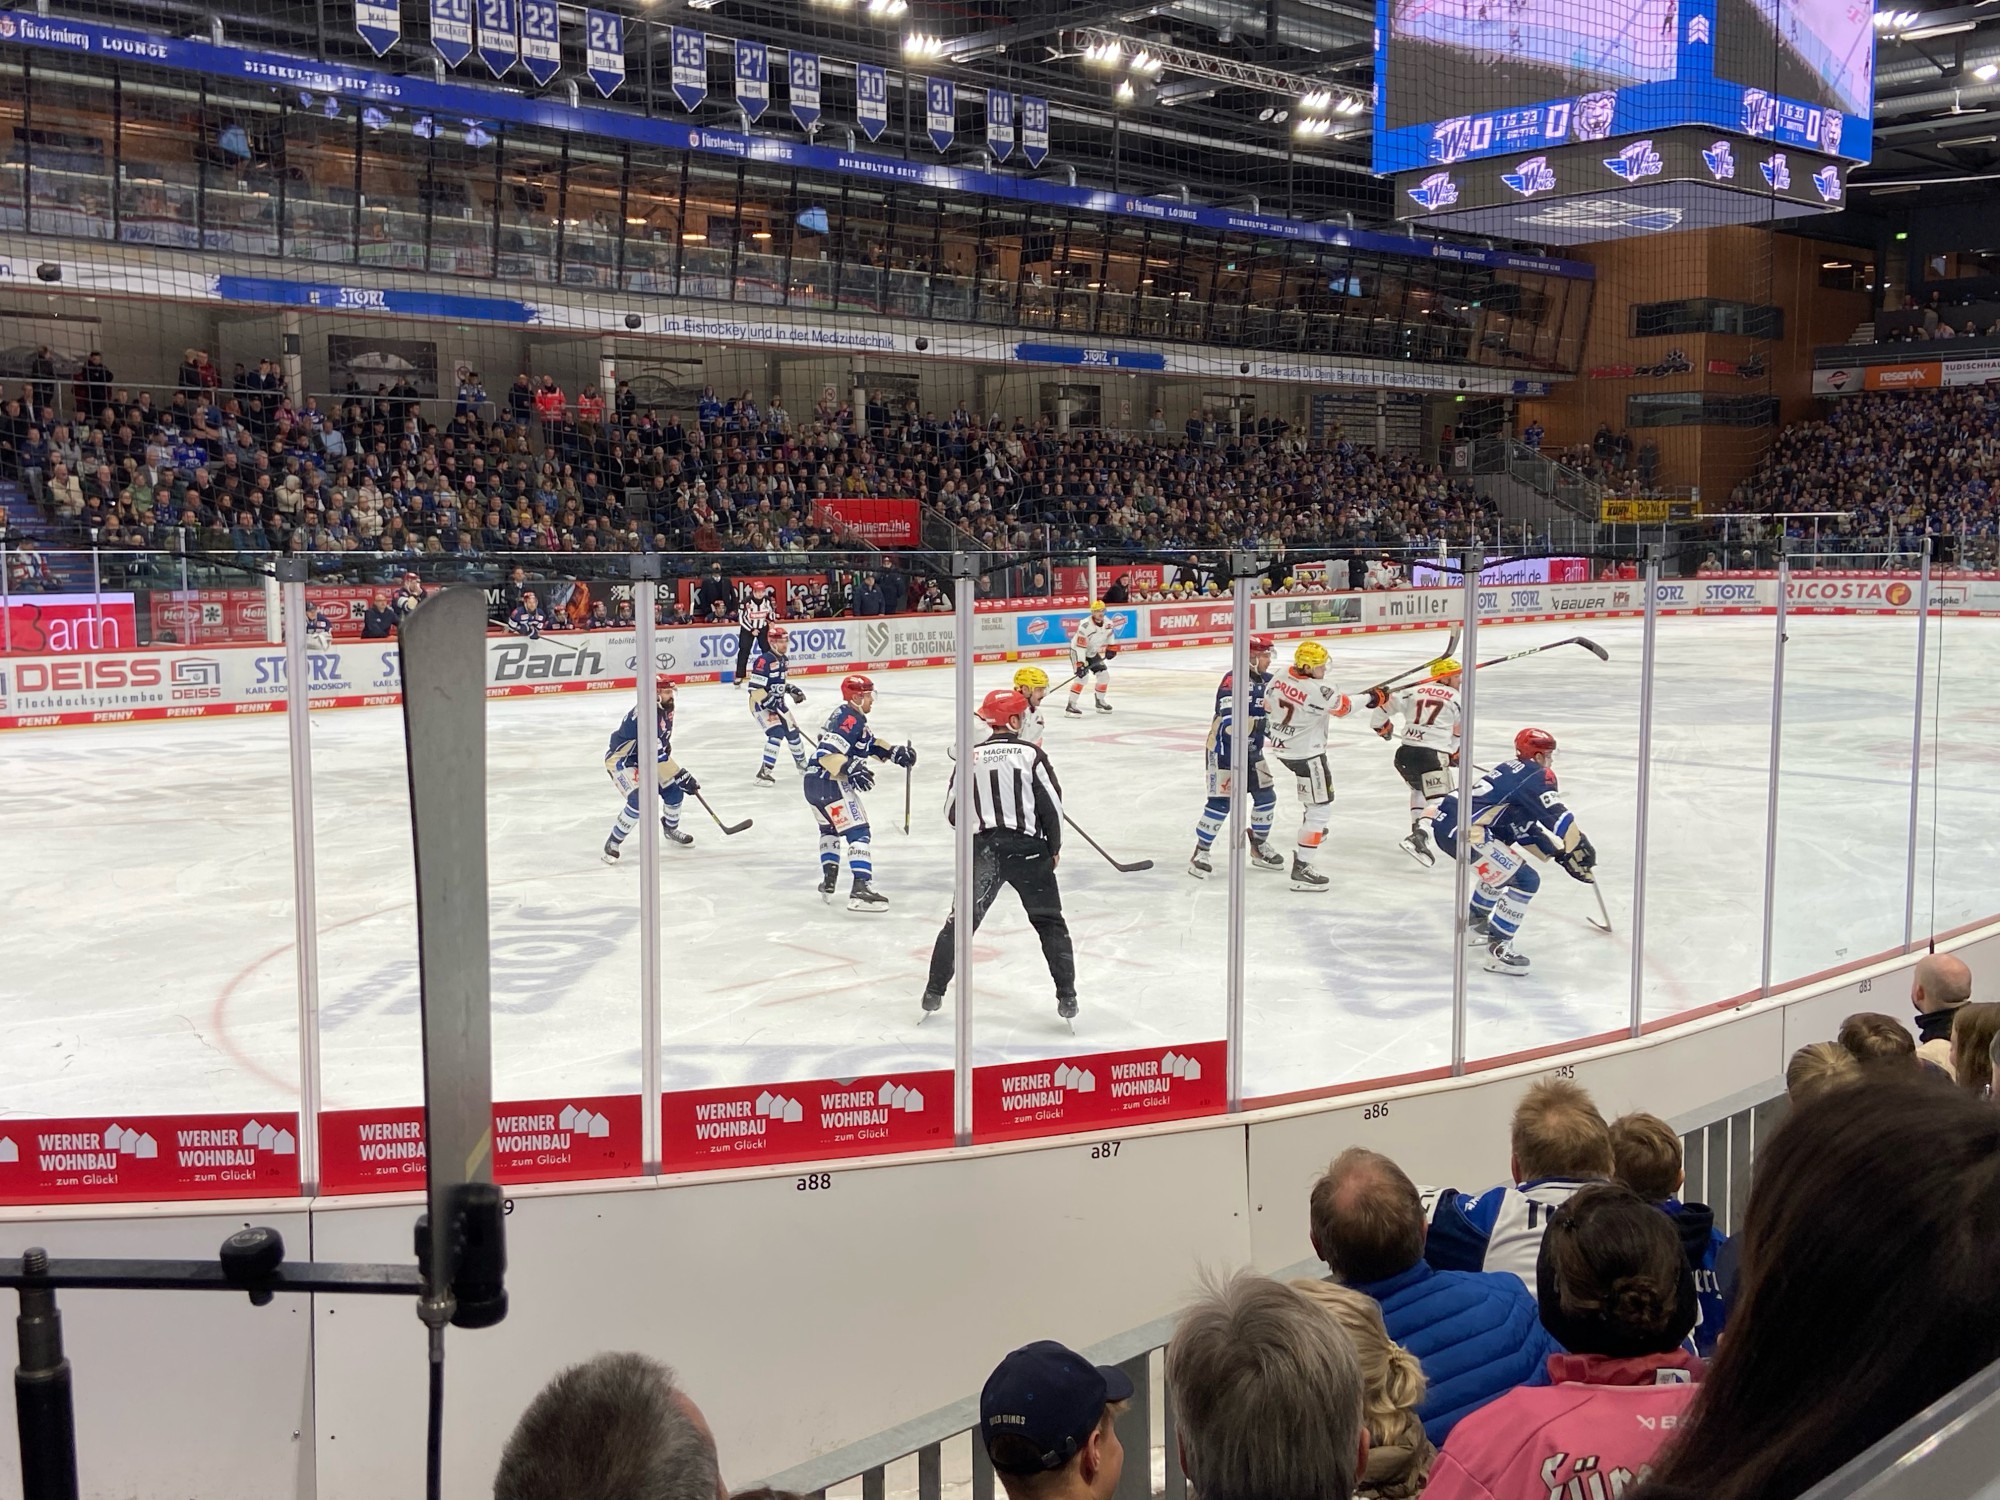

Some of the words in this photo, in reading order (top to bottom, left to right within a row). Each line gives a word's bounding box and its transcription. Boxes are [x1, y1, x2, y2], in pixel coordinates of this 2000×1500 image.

[525, 4, 555, 39] 22
[20, 18, 90, 50] Fürstenberg
[102, 35, 168, 58] LOUNGE
[590, 16, 618, 51] 24
[676, 33, 702, 66] 25
[740, 47, 763, 78] 27
[244, 60, 332, 84] BIERKULTUR
[337, 77, 368, 90] SEIT
[793, 57, 816, 86] 28
[860, 70, 883, 99] 30
[932, 85, 949, 112] 31
[1026, 102, 1044, 129] 98
[1470, 117, 1493, 152] 0
[1546, 103, 1571, 140] 0
[1806, 109, 1821, 143] 0
[340, 287, 385, 306] STORZ
[664, 317, 680, 331] Im
[684, 319, 746, 338] Eishockey
[750, 325, 773, 339] und
[776, 327, 786, 339] in
[790, 328, 808, 341] der
[1880, 368, 1926, 383] reservix
[1511, 590, 1540, 606] STORZ
[1706, 584, 1755, 600] STORZ
[1786, 583, 1882, 599] RICOSTA
[1390, 594, 1448, 616] müller
[1478, 592, 1498, 609] ORZ
[164, 609, 200, 621] Helos
[1160, 614, 1200, 629] PENNY.
[1210, 613, 1234, 626] PEN
[608, 636, 637, 646] Mobilitä
[655, 635, 675, 645] ewegt
[788, 628, 846, 653] STORZ
[895, 634, 903, 642] BE
[906, 632, 925, 641] WILD.
[927, 631, 936, 640] BE
[939, 630, 955, 640] YOU.
[821, 651, 853, 659] ENDOSKOPE
[895, 643, 909, 656] BE
[490, 643, 605, 681] Bach
[693, 660, 709, 668] KARL
[710, 659, 729, 667] STORZ
[16, 658, 161, 693] DEISS
[373, 680, 391, 688] KARL
[685, 673, 711, 683] PENNY.
[172, 687, 221, 700] DEISS
[245, 686, 268, 695] KARL
[308, 681, 352, 691] NDOSKOPE
[486, 687, 511, 697] ENNY.
[534, 683, 564, 694] PENNY.
[586, 680, 615, 691] PENNY.
[1274, 680, 1308, 703] ORION
[1417, 687, 1455, 700] ORION
[17, 692, 164, 709] Flachdachsystembau
[235, 702, 273, 714] PENNY.
[308, 698, 338, 708] ENNY.
[363, 695, 398, 706] PENNY.
[93, 710, 135, 723] PENNY.
[166, 706, 206, 718] PENNY.
[1278, 698, 1295, 726] 7
[1414, 699, 1445, 726] 17
[18, 714, 62, 728] PENNY.
[1405, 728, 1425, 741] NIX
[983, 747, 1022, 756] MAGENTA
[983, 755, 1008, 764] SPORT
[1425, 777, 1442, 787] NIX
[1111, 1061, 1158, 1080] WERNER
[1002, 1073, 1050, 1093] WERNER
[1111, 1077, 1170, 1098] WOHNBAU
[821, 1091, 875, 1110] WERNER
[1002, 1090, 1063, 1111] WOHNBAU
[1123, 1102, 1140, 1110] zum
[1143, 1097, 1170, 1108] Glück!
[696, 1101, 751, 1120] WERNER
[821, 1109, 888, 1129] WOHNBAU
[1014, 1114, 1032, 1124] zum
[1035, 1109, 1064, 1121] Glück!
[1364, 1103, 1389, 1121] a86
[359, 1122, 420, 1141] WERNER
[496, 1114, 554, 1133] WERNER
[696, 1119, 766, 1140] WOHNBAU
[38, 1132, 100, 1151] WERNER
[178, 1129, 238, 1148] WERNER
[496, 1133, 570, 1153] WOHNBAU
[834, 1133, 854, 1142] zum
[858, 1129, 889, 1140] Glück!
[360, 1142, 427, 1161] WOHNBA
[710, 1144, 731, 1153] zum
[734, 1139, 767, 1150] Glück!
[1091, 1141, 1121, 1159] a87
[39, 1153, 118, 1172] WOHNBAU
[178, 1149, 255, 1168] WOHNBAU
[511, 1157, 533, 1167] zum
[537, 1153, 571, 1165] Glück!
[194, 1173, 218, 1183] zum
[221, 1169, 256, 1181] Glück!
[376, 1166, 399, 1175] zum
[402, 1163, 427, 1173] Glüc
[56, 1177, 79, 1186] zum
[83, 1174, 119, 1185] Glück!
[796, 1174, 832, 1191] a88
[988, 1414, 1002, 1427] WILD
[1002, 1414, 1026, 1425] WINGS
